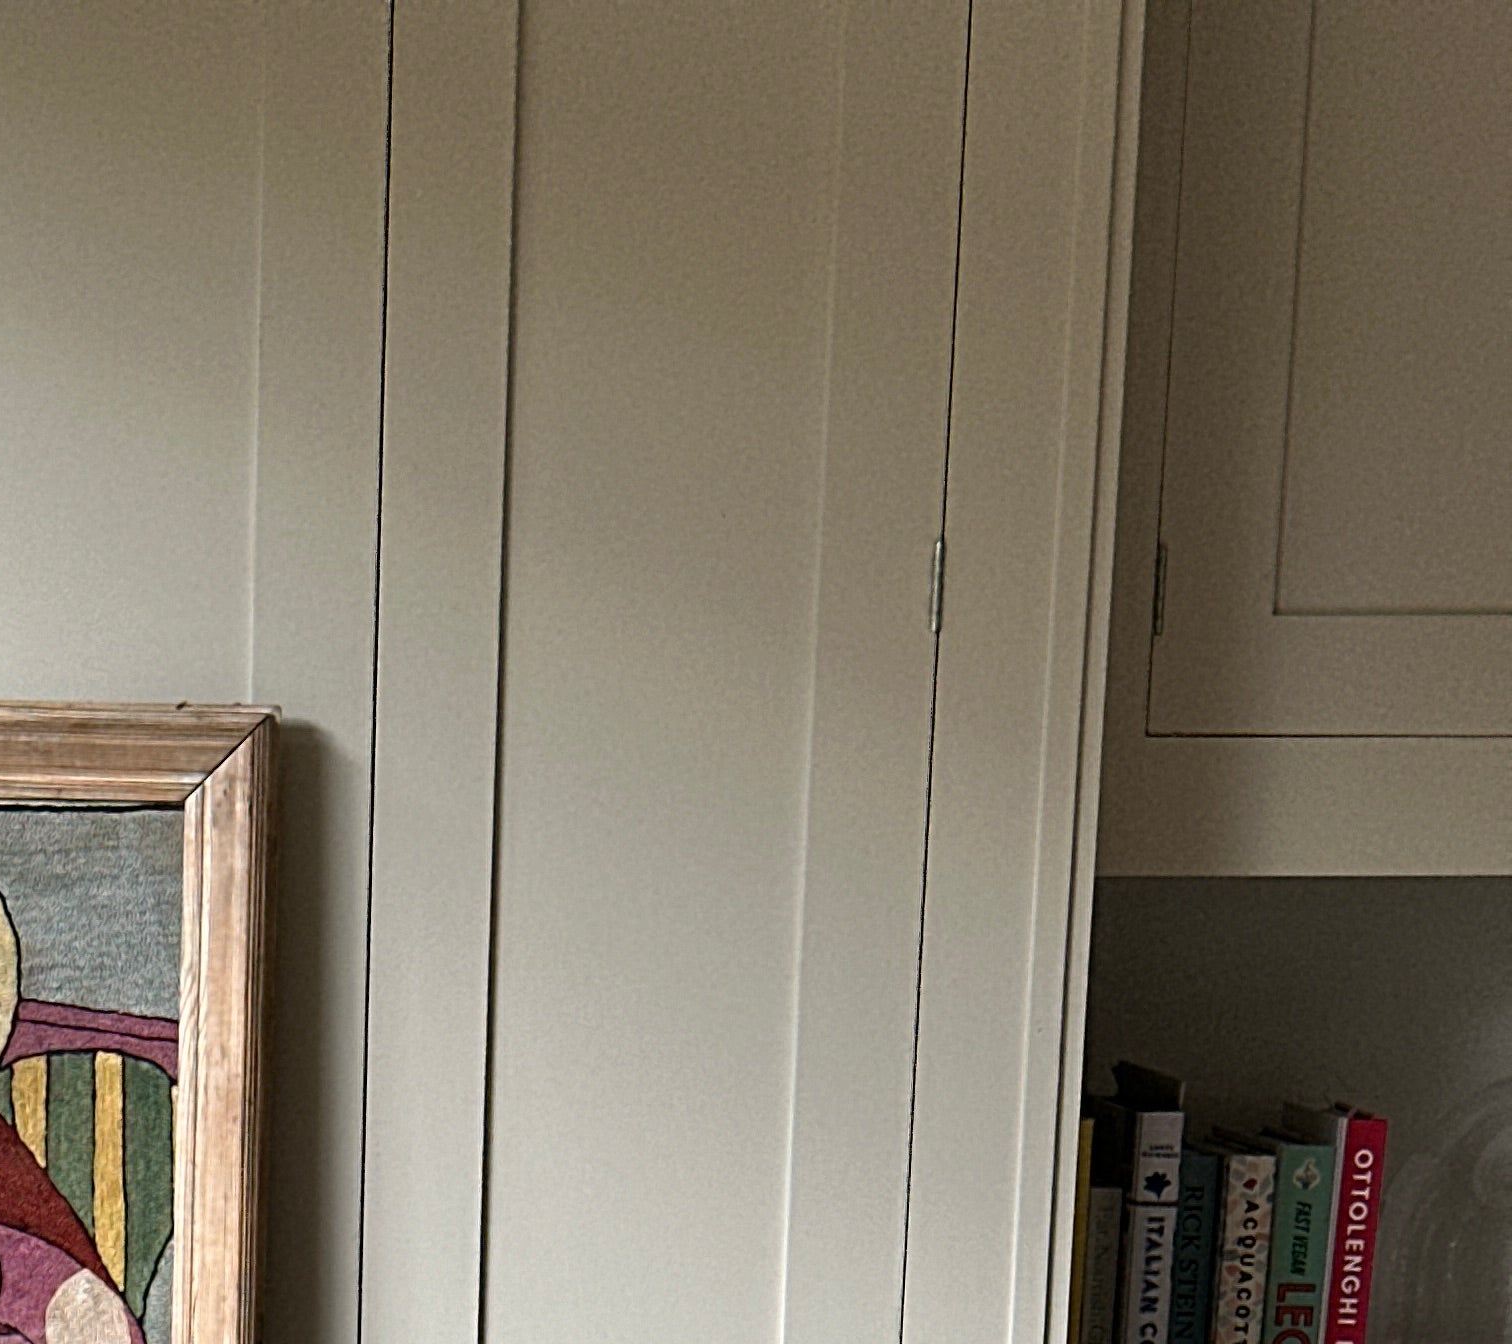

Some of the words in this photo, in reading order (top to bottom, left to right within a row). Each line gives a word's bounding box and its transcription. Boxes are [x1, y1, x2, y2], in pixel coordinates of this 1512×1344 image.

[1180, 1185, 1205, 1251] RICK
[1294, 1200, 1313, 1234] FAST
[1337, 1148, 1374, 1326] OTTOLENGHI
[1138, 1215, 1165, 1315] ITALIAN
[1290, 1234, 1309, 1277] VEGAN
[1175, 1259, 1199, 1340] STEIN
